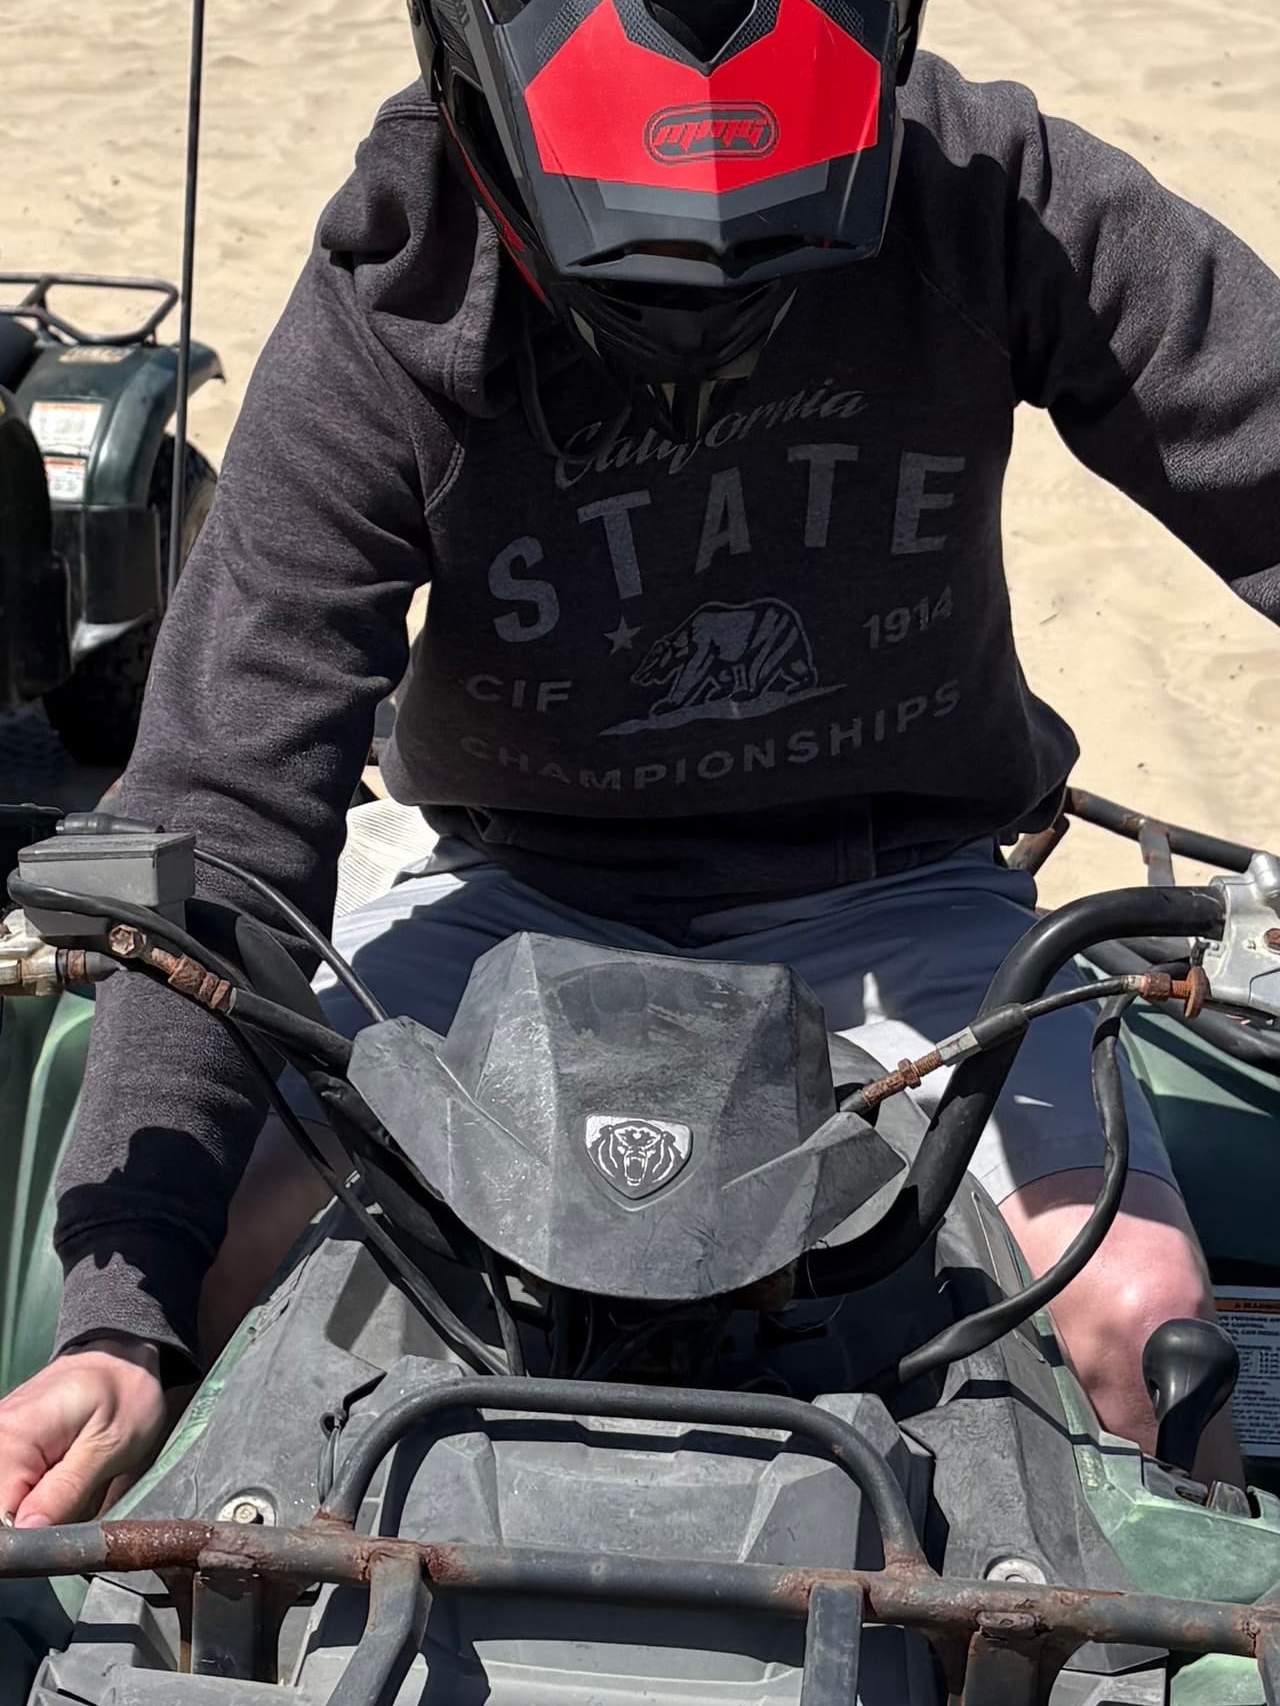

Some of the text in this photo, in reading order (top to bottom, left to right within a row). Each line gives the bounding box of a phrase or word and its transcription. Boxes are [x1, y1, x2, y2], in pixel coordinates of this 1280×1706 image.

[486, 443, 966, 645] STATE
[861, 584, 956, 651] 1914
[460, 678, 964, 791] CHAMPIONSHIPS
[463, 672, 573, 714] CIF
